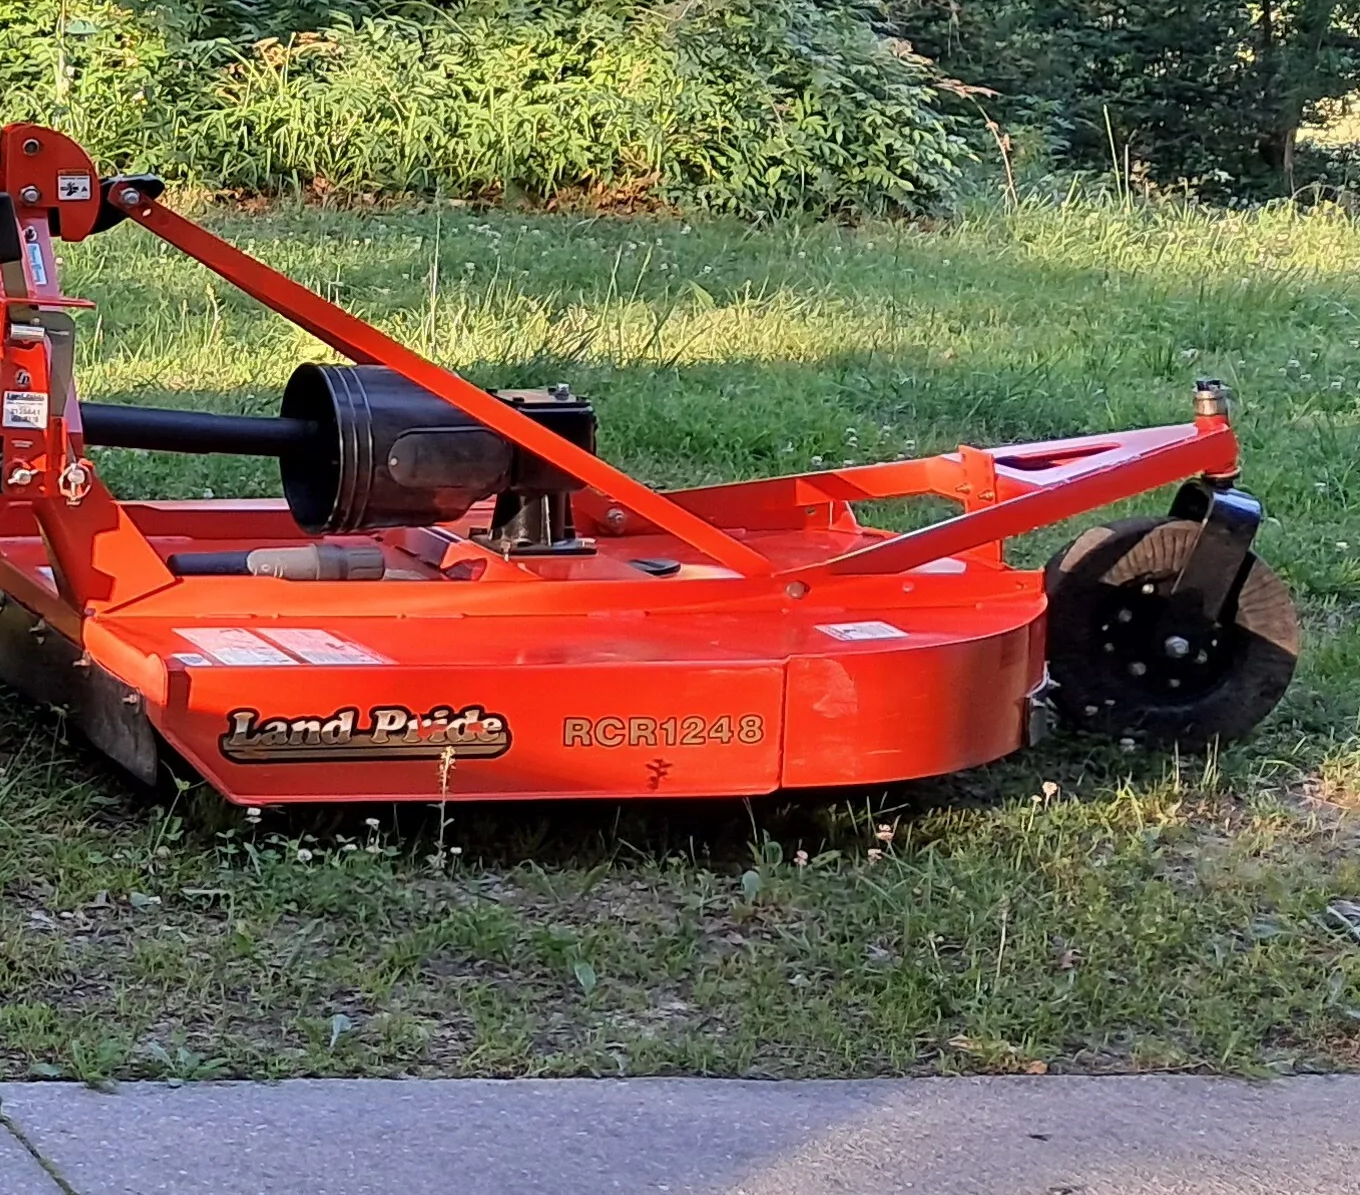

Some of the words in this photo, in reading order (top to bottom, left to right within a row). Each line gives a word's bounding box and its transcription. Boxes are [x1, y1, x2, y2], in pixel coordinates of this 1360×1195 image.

[228, 709, 356, 747] Land
[370, 708, 504, 744] Pride
[563, 714, 765, 748] RCR1248
